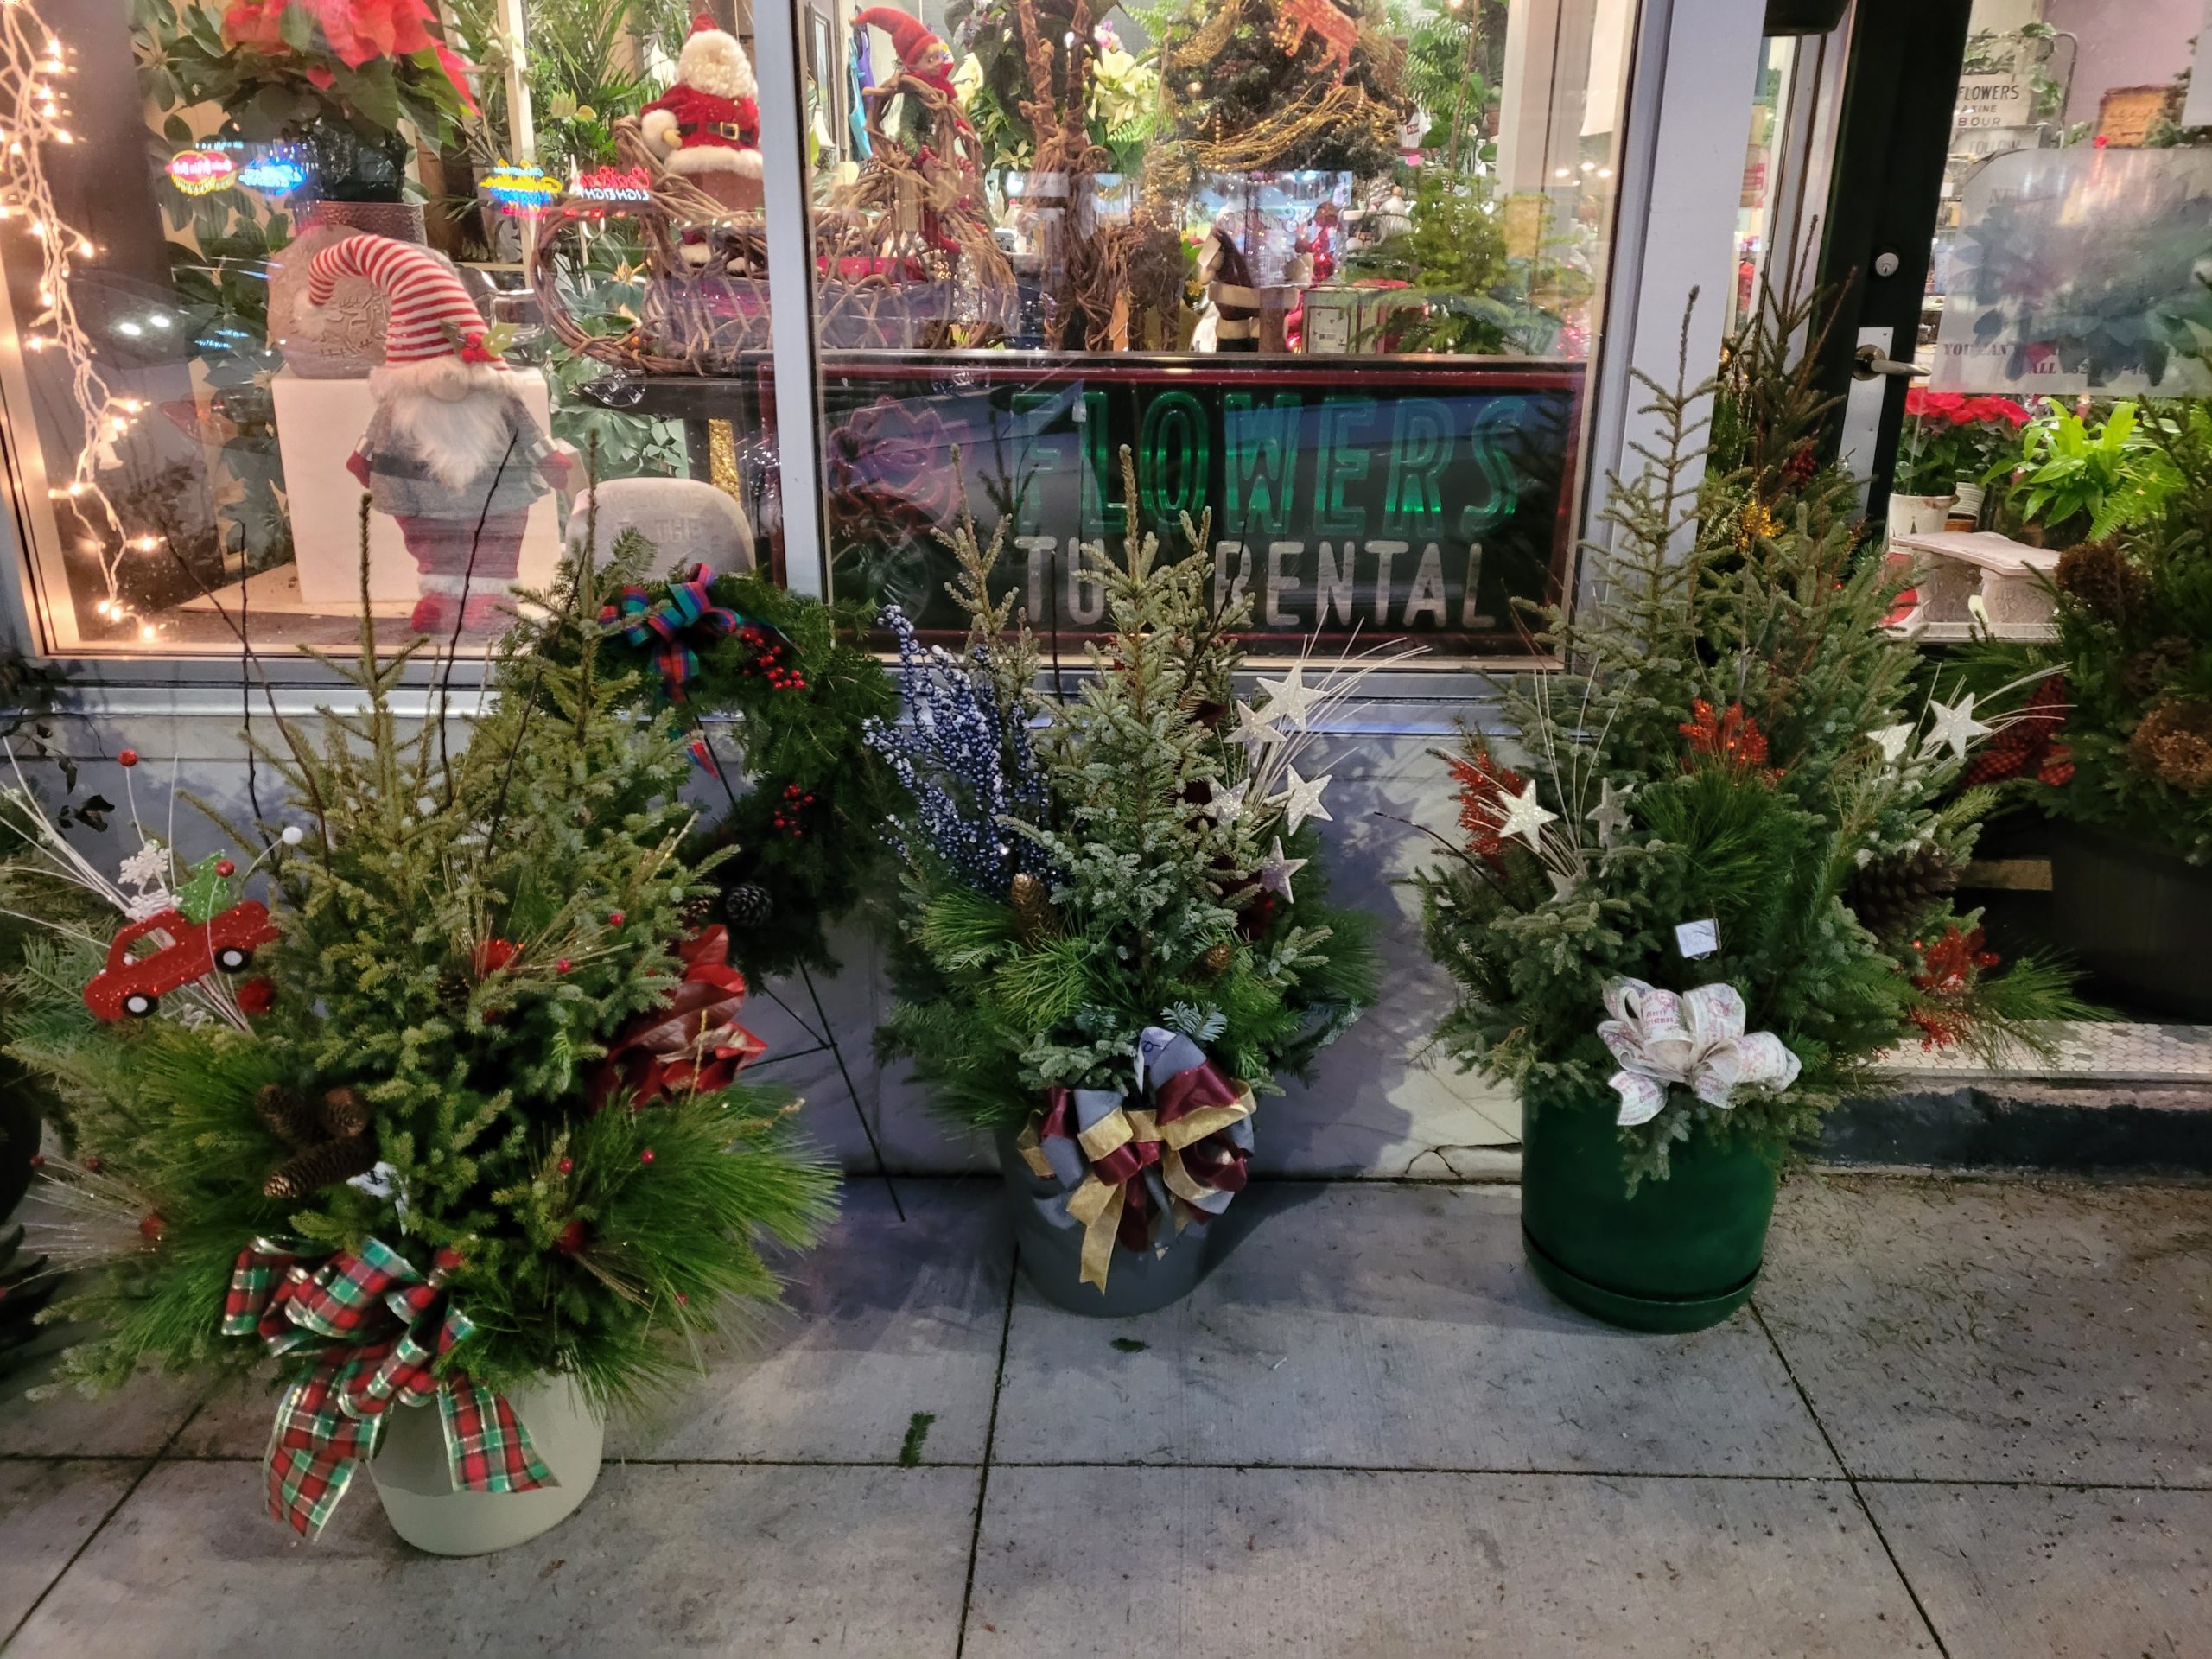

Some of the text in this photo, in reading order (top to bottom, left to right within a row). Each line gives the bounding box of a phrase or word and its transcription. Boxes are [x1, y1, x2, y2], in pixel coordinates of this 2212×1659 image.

[1958, 84, 2019, 100] FLOWERS
[1011, 391, 1526, 537] FLOWERS
[654, 518, 701, 543] THE
[1214, 540, 1496, 628] RENTAL
